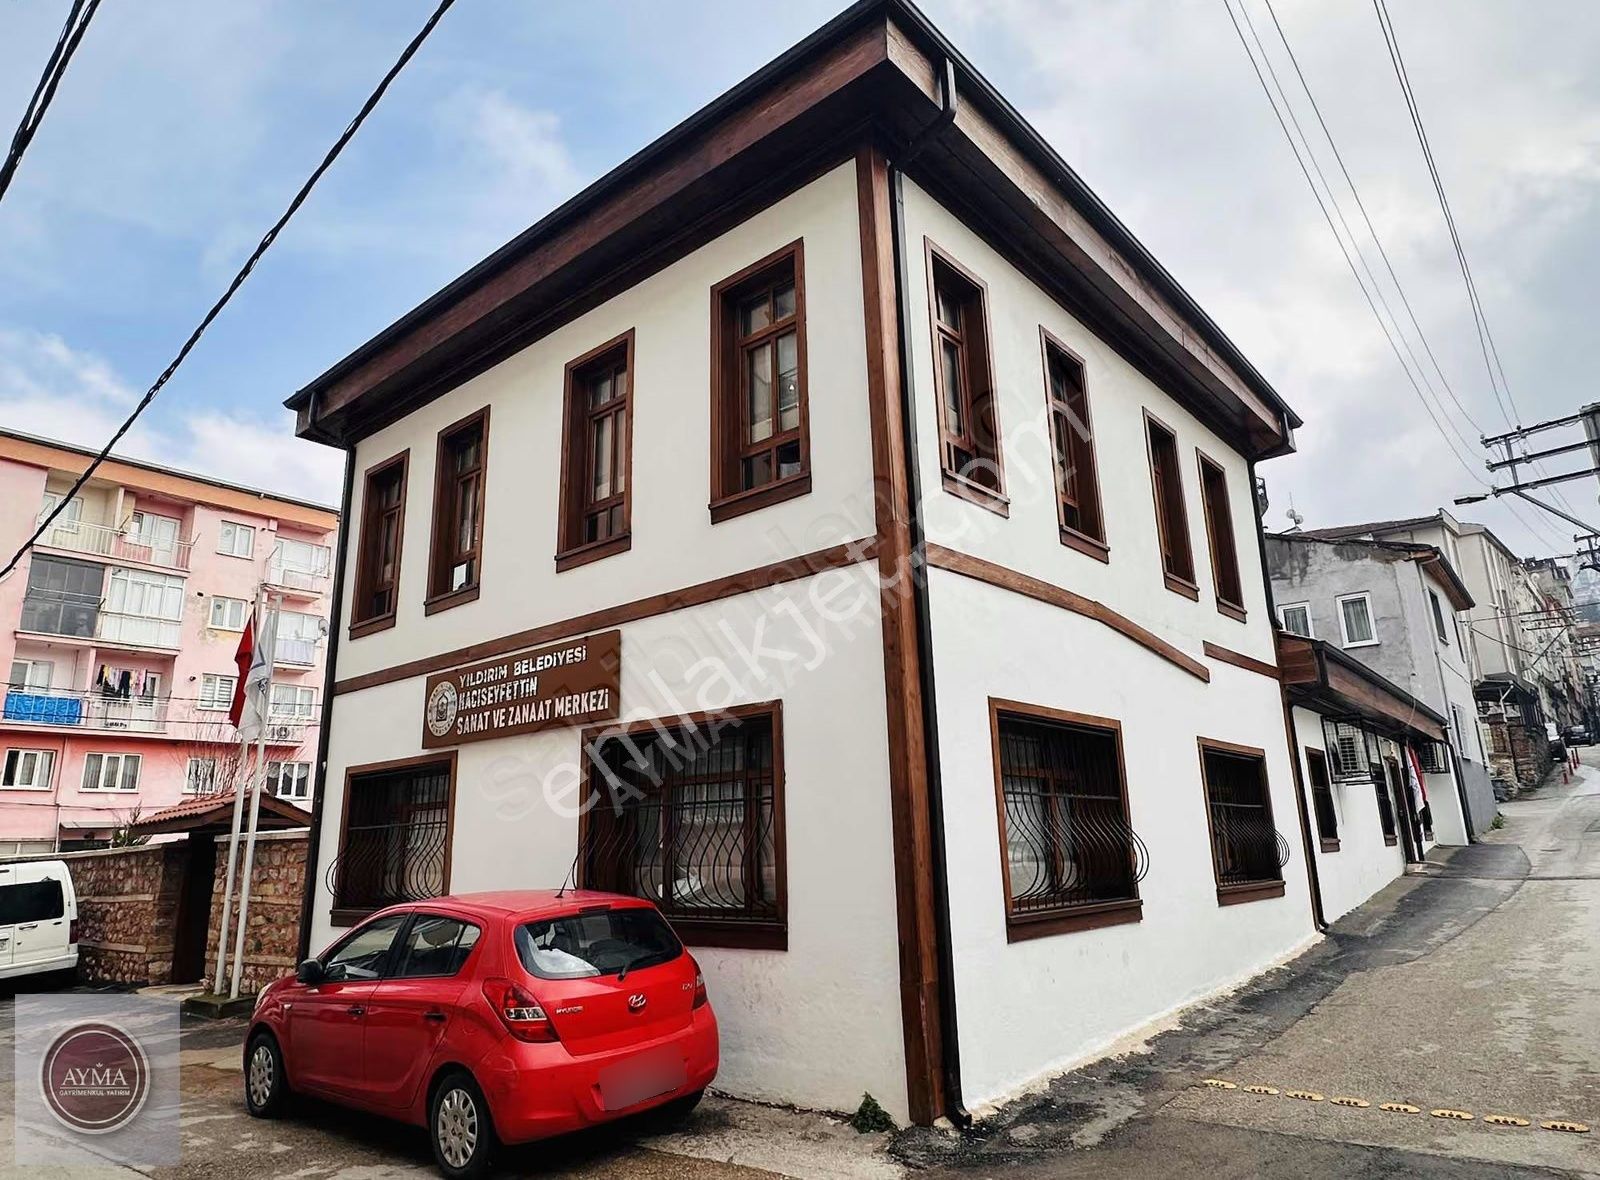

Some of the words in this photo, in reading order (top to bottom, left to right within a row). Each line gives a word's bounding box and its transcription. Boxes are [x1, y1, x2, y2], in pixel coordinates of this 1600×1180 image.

[459, 664, 508, 689] YILDIRIM
[513, 645, 587, 676] BELEDİYESİ
[456, 710, 490, 735] SANAT
[492, 706, 506, 729] VE
[507, 699, 552, 727] ZANAAT
[553, 688, 609, 718] MERKEZİ
[457, 676, 538, 711] HACISEYFETTİN
